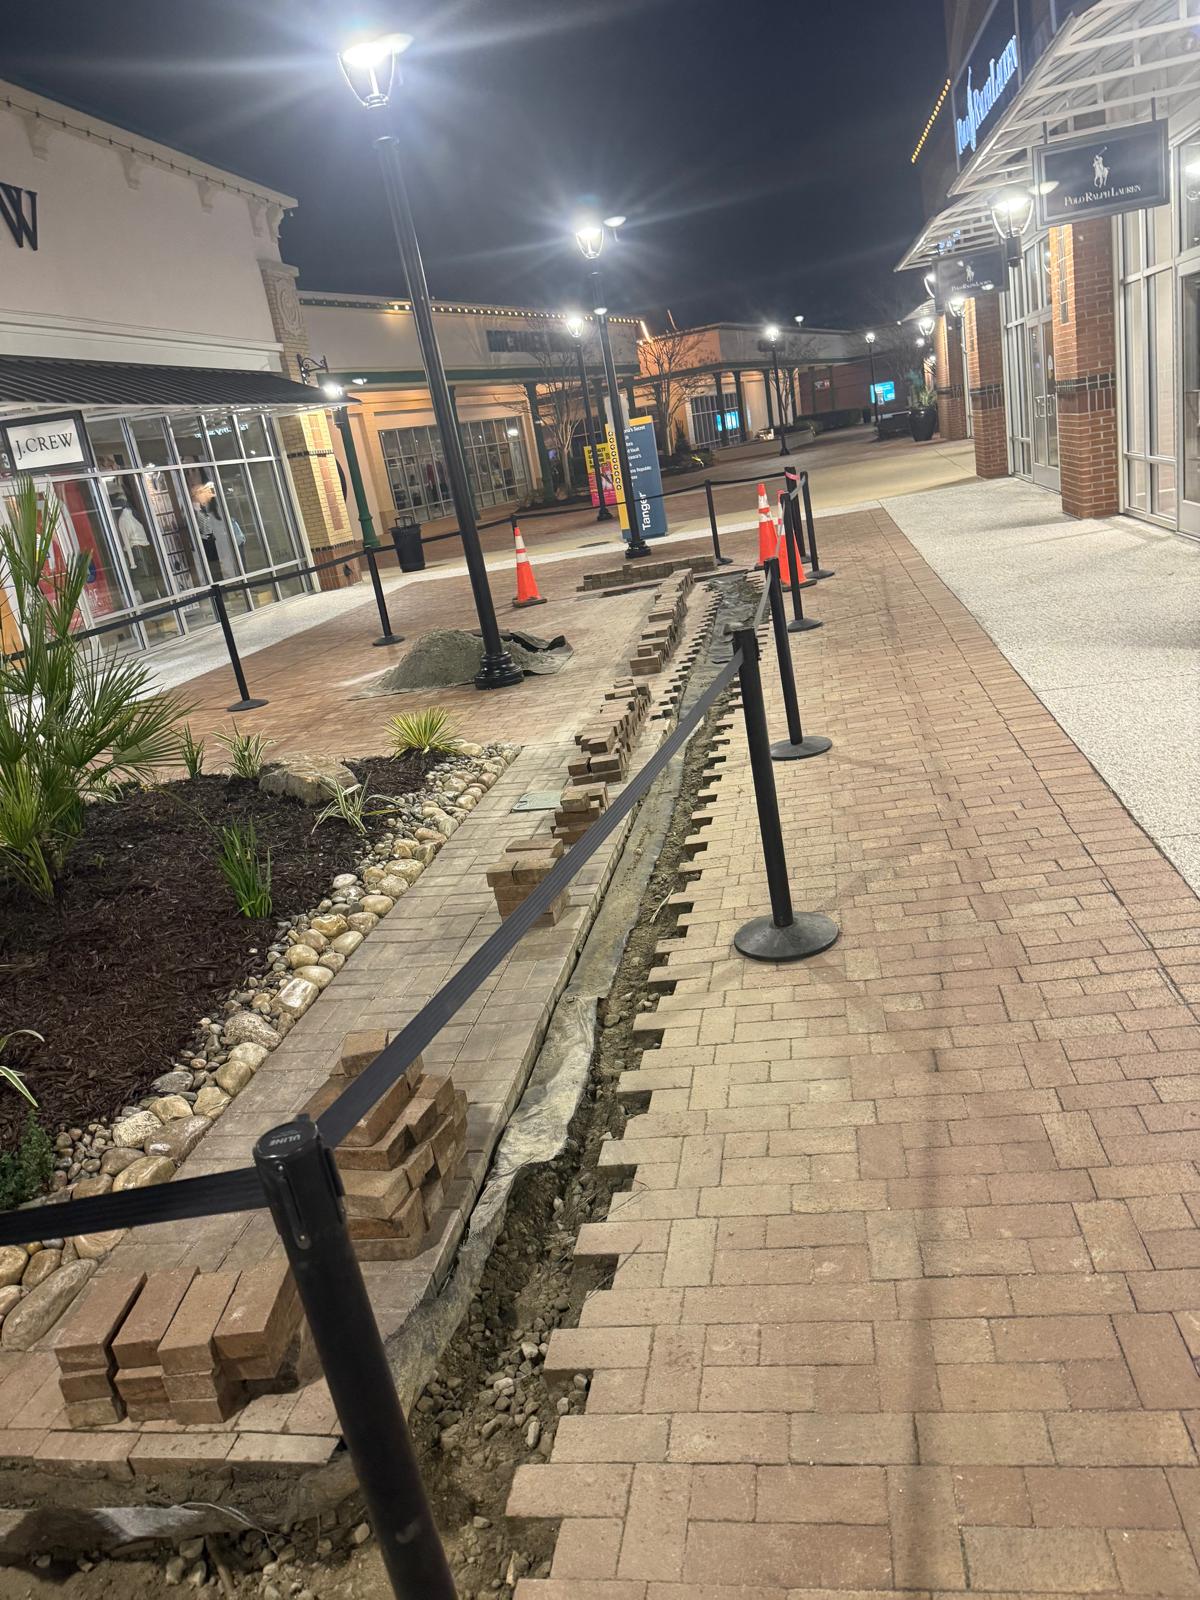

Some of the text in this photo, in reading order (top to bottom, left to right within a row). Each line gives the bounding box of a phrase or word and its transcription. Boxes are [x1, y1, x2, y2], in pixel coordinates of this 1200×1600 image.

[1085, 190, 1110, 203] RALPH
[1111, 184, 1142, 197] LAUREN
[15, 432, 73, 461] J.CREW
[638, 490, 651, 531] Tanger
